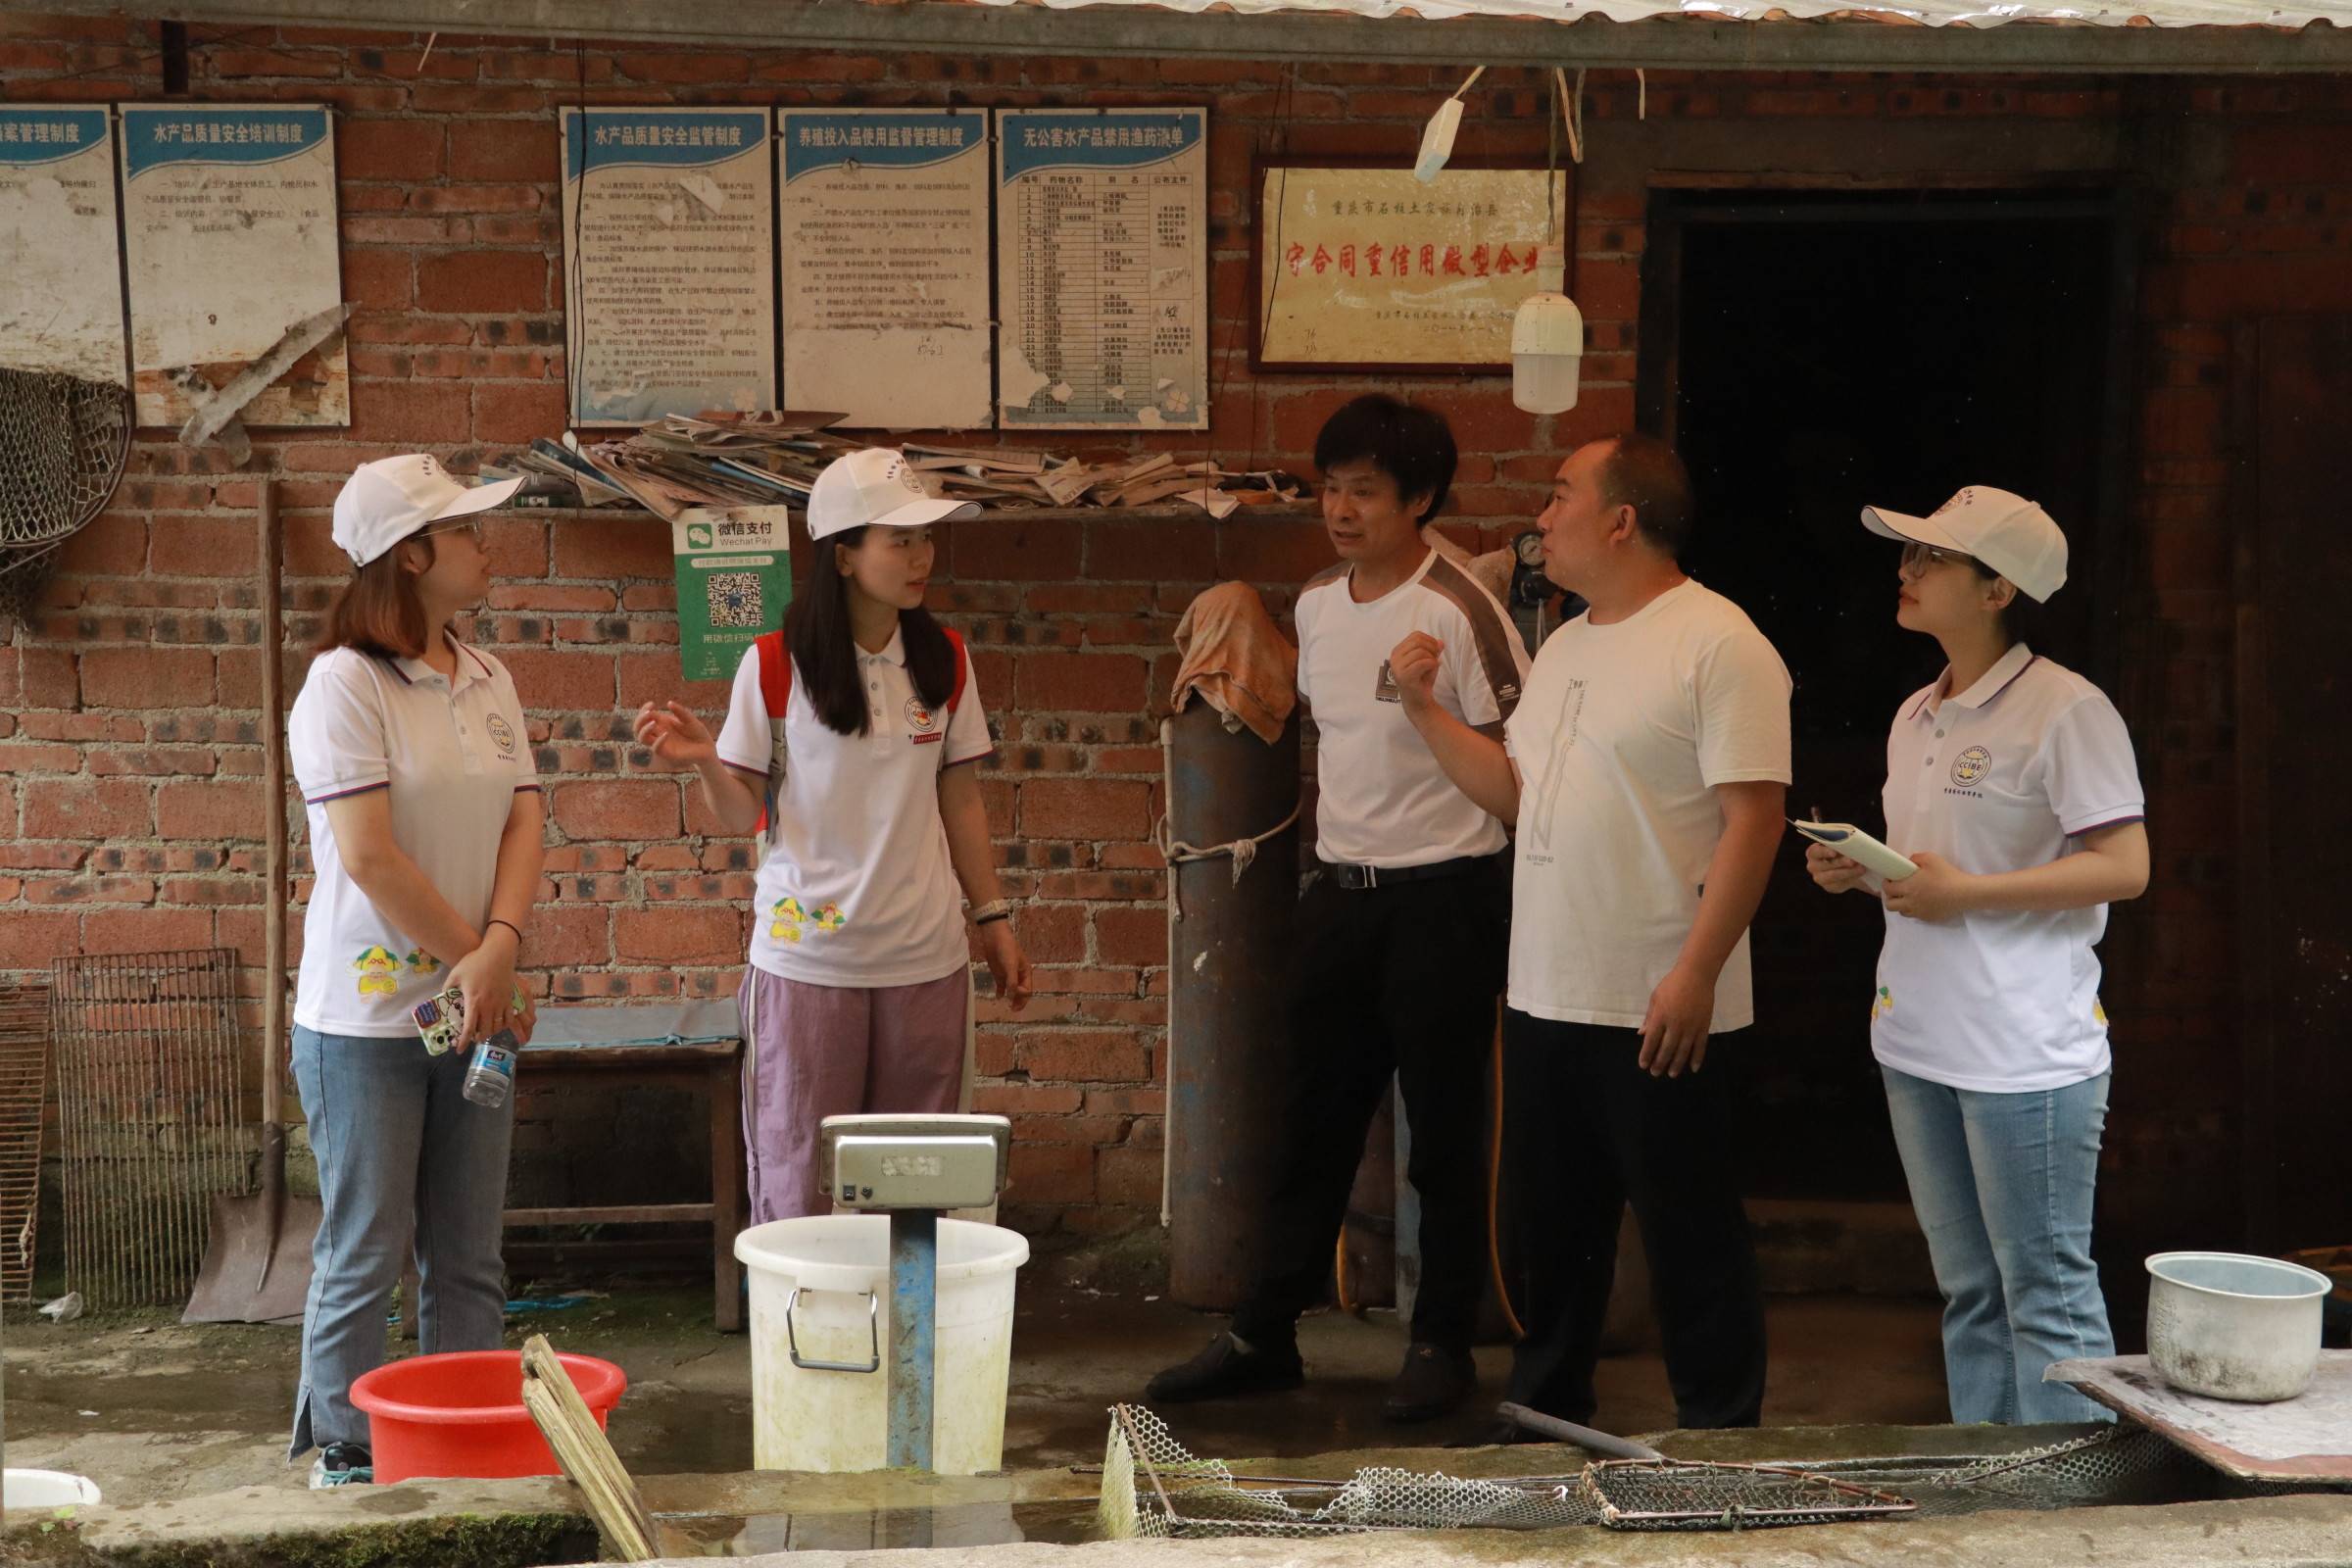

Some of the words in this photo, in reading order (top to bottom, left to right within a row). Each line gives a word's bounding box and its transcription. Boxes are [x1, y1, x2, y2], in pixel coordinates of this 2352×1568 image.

[0, 123, 79, 143] 案管理制度
[154, 123, 304, 144] 水产品质量安全培训制度
[594, 124, 742, 147] 水产品质量安全监管制度
[799, 125, 964, 148] 养殖投入品使用监督管理制度
[1023, 125, 1185, 148] 无公害水产品禁用渔药清单
[1284, 240, 1540, 278] 守合同重信用微型企业
[717, 521, 773, 537] 微信支付
[755, 535, 773, 547] Pay
